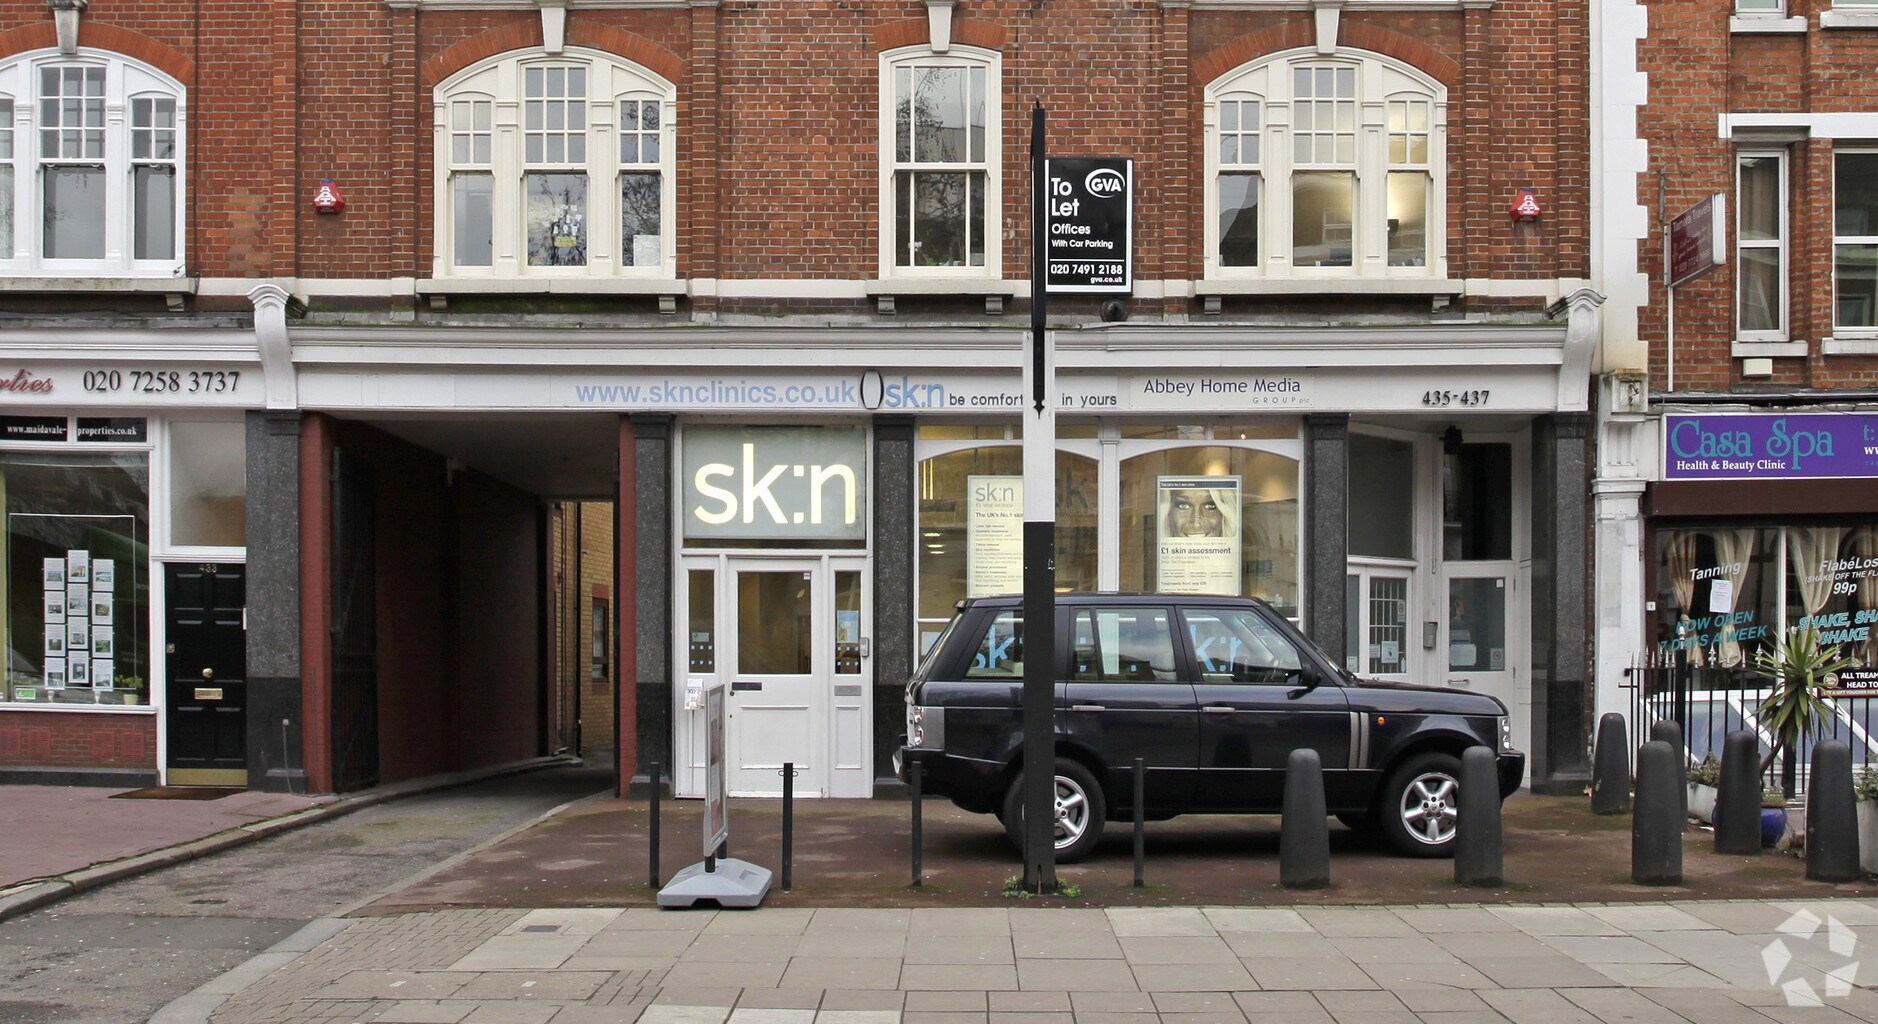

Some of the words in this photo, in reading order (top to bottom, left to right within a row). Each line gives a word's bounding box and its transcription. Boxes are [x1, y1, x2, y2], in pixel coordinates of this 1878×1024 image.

[1051, 178, 1072, 196] To
[1091, 178, 1122, 192] GVA
[1051, 198, 1080, 216] Let
[1052, 223, 1091, 235] Offices
[1052, 240, 1068, 248] With
[1069, 240, 1084, 248] Car
[1085, 240, 1114, 249] Parking
[1051, 264, 1069, 275] 020
[1072, 264, 1095, 275] 7491
[1098, 264, 1123, 275] 2188
[1090, 276, 1123, 284] gva.co.uk
[83, 370, 121, 391] 020
[130, 371, 180, 392] 7258
[188, 371, 240, 392] 3737
[1143, 379, 1195, 397] Abbey
[1201, 379, 1248, 393] Home
[1253, 378, 1300, 393] Media
[576, 380, 855, 404] www.sknclinics.co.uk
[950, 393, 965, 406] be
[971, 393, 1023, 406] comfort
[1061, 393, 1073, 406] in
[1081, 395, 1117, 408] yours
[1422, 390, 1490, 406] 435-437
[1671, 419, 1753, 458] Casa
[1766, 418, 1834, 470] Spa
[1676, 460, 1709, 470] Health
[1711, 460, 1720, 470] &
[1722, 460, 1755, 472] Beauty
[1757, 460, 1786, 470] Clinic
[694, 443, 856, 524] sk:n
[1690, 562, 1741, 581] Tanning
[1834, 572, 1850, 580] OFF
[1851, 570, 1867, 579] THE
[1833, 582, 1857, 596] 99p
[1714, 610, 1754, 627] OPEN
[1671, 634, 1709, 651] DAYS
[1726, 625, 1768, 642] WEEK
[1820, 627, 1870, 645] SHAKE
